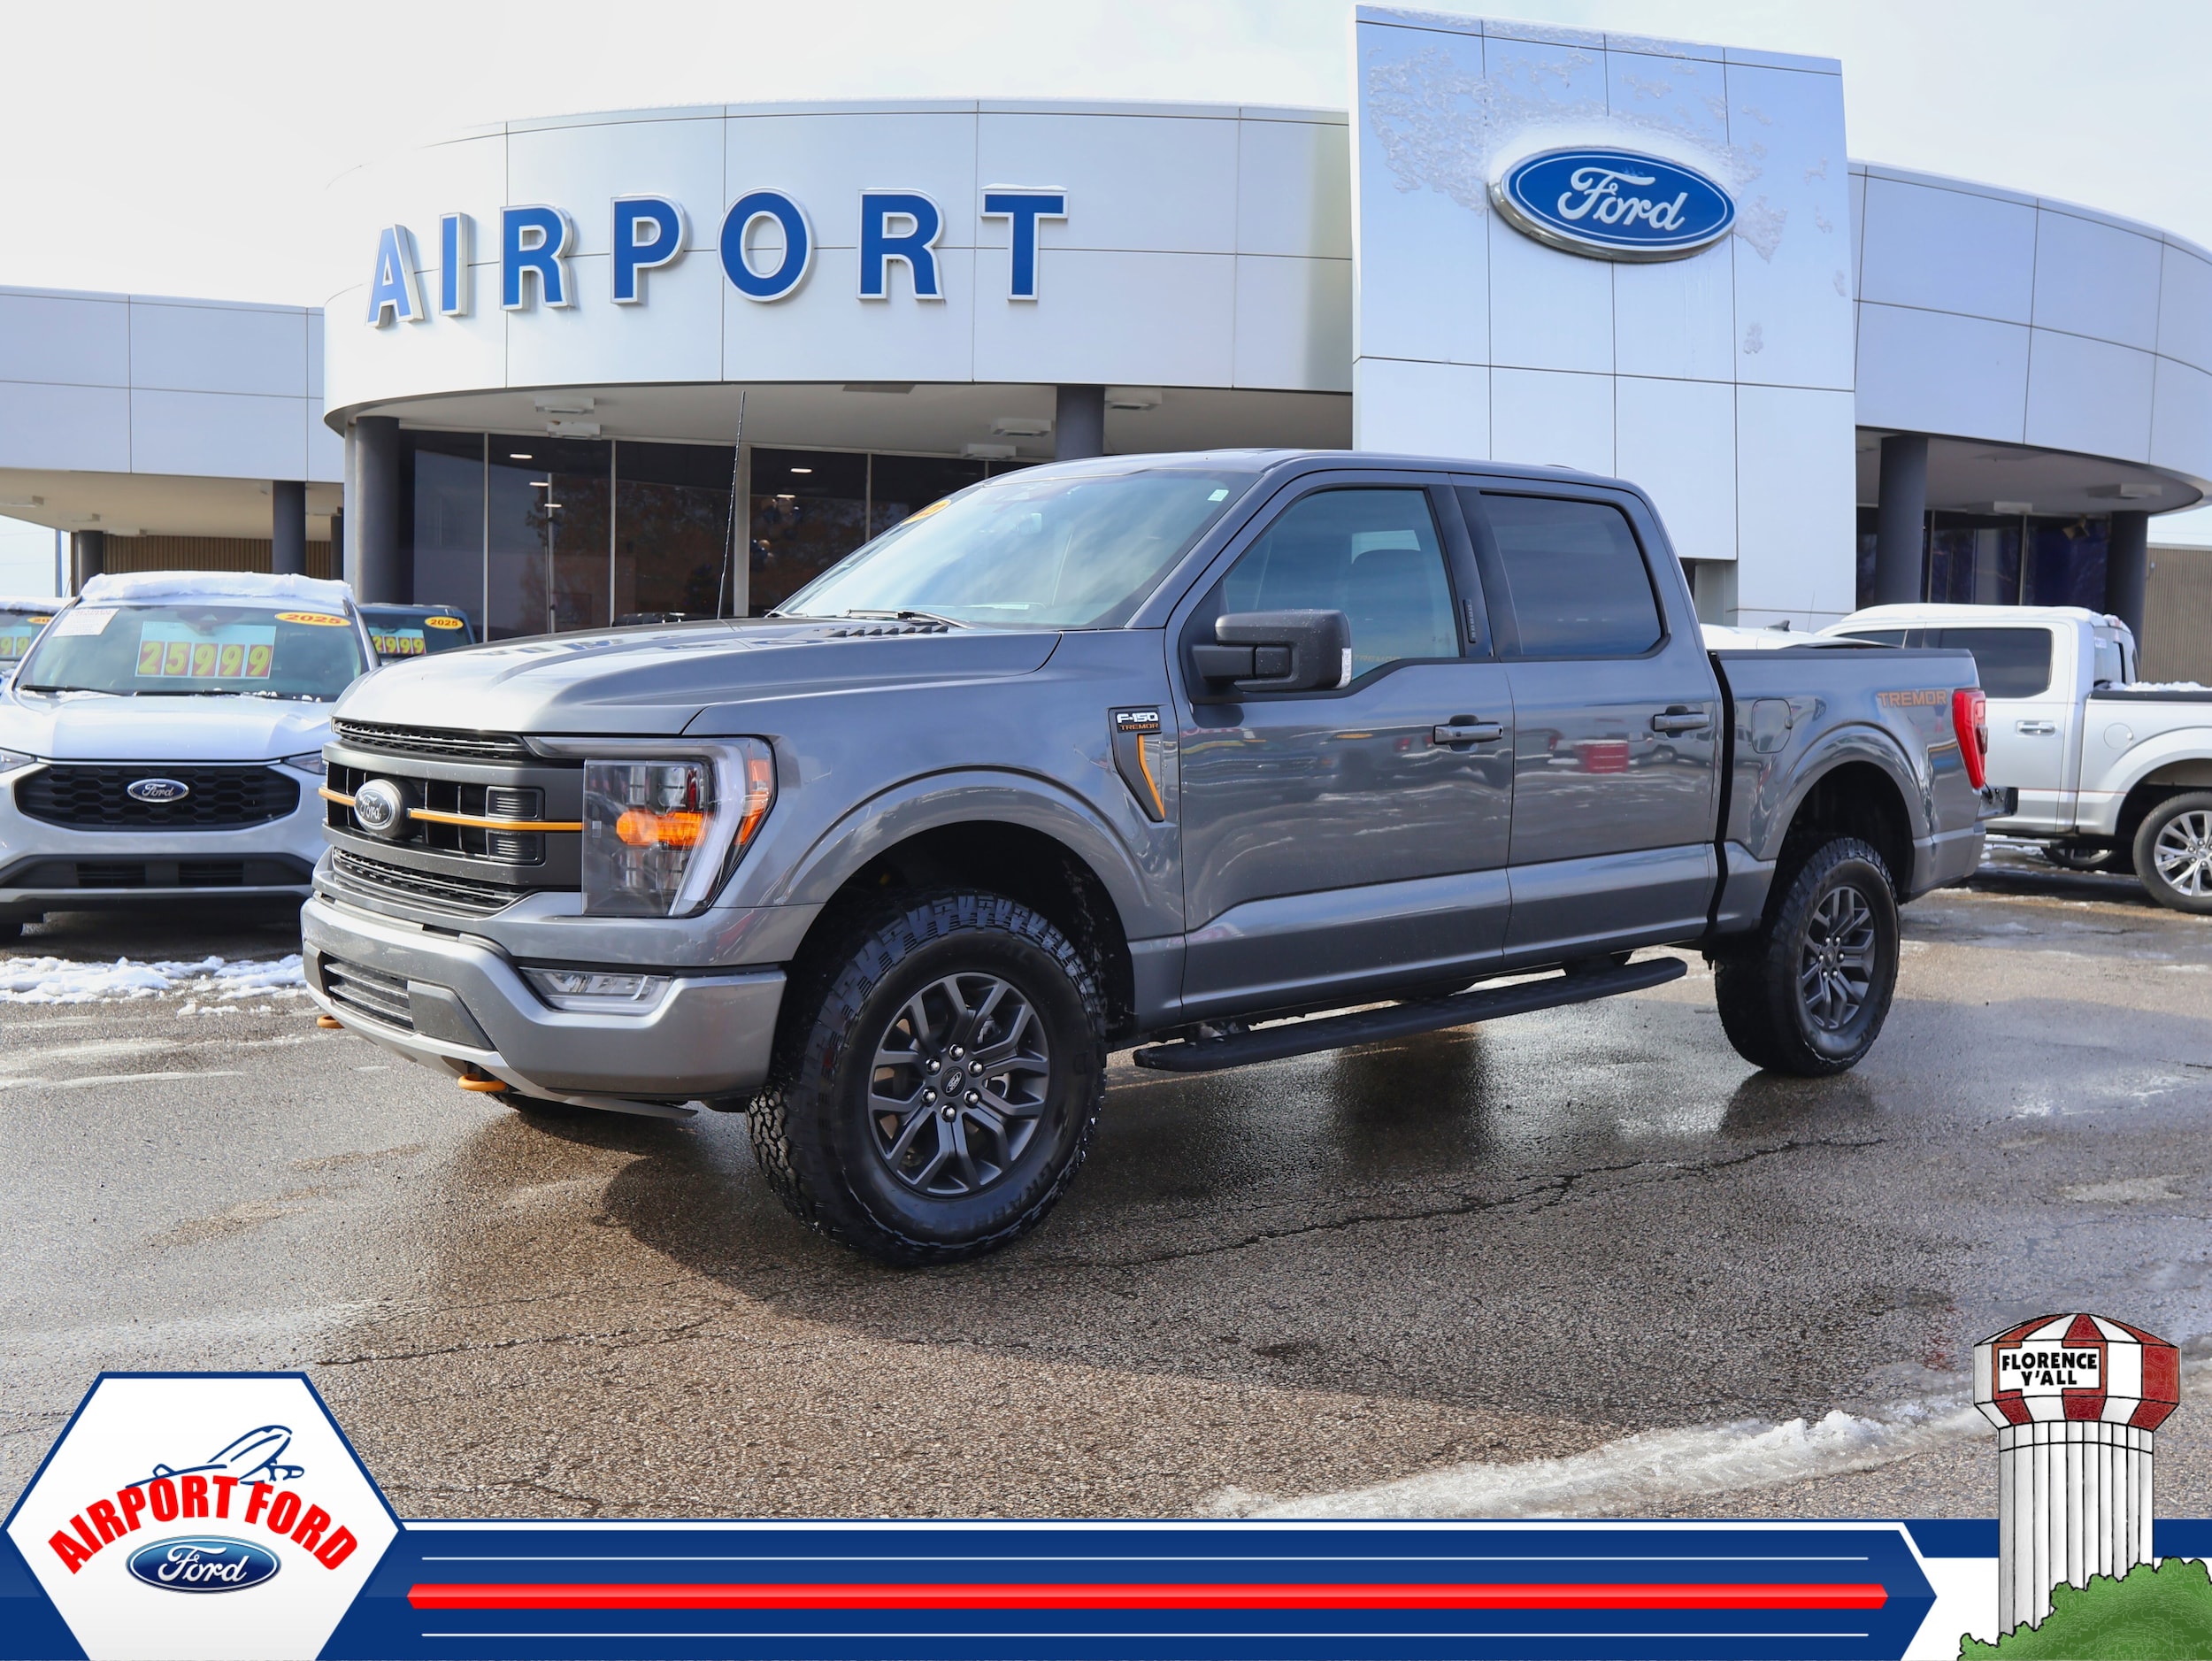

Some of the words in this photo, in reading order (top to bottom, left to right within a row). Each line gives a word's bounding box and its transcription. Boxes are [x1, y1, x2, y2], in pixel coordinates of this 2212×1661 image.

[1557, 166, 1687, 231] Ford
[365, 184, 1068, 328] AIRPORT
[284, 613, 342, 624] 2025
[430, 618, 458, 627] 2025
[138, 641, 271, 676] 25999
[1877, 689, 1947, 707] TREMOR
[1117, 711, 1158, 724] F-150
[142, 783, 175, 796] Ford
[358, 793, 382, 821] Ford
